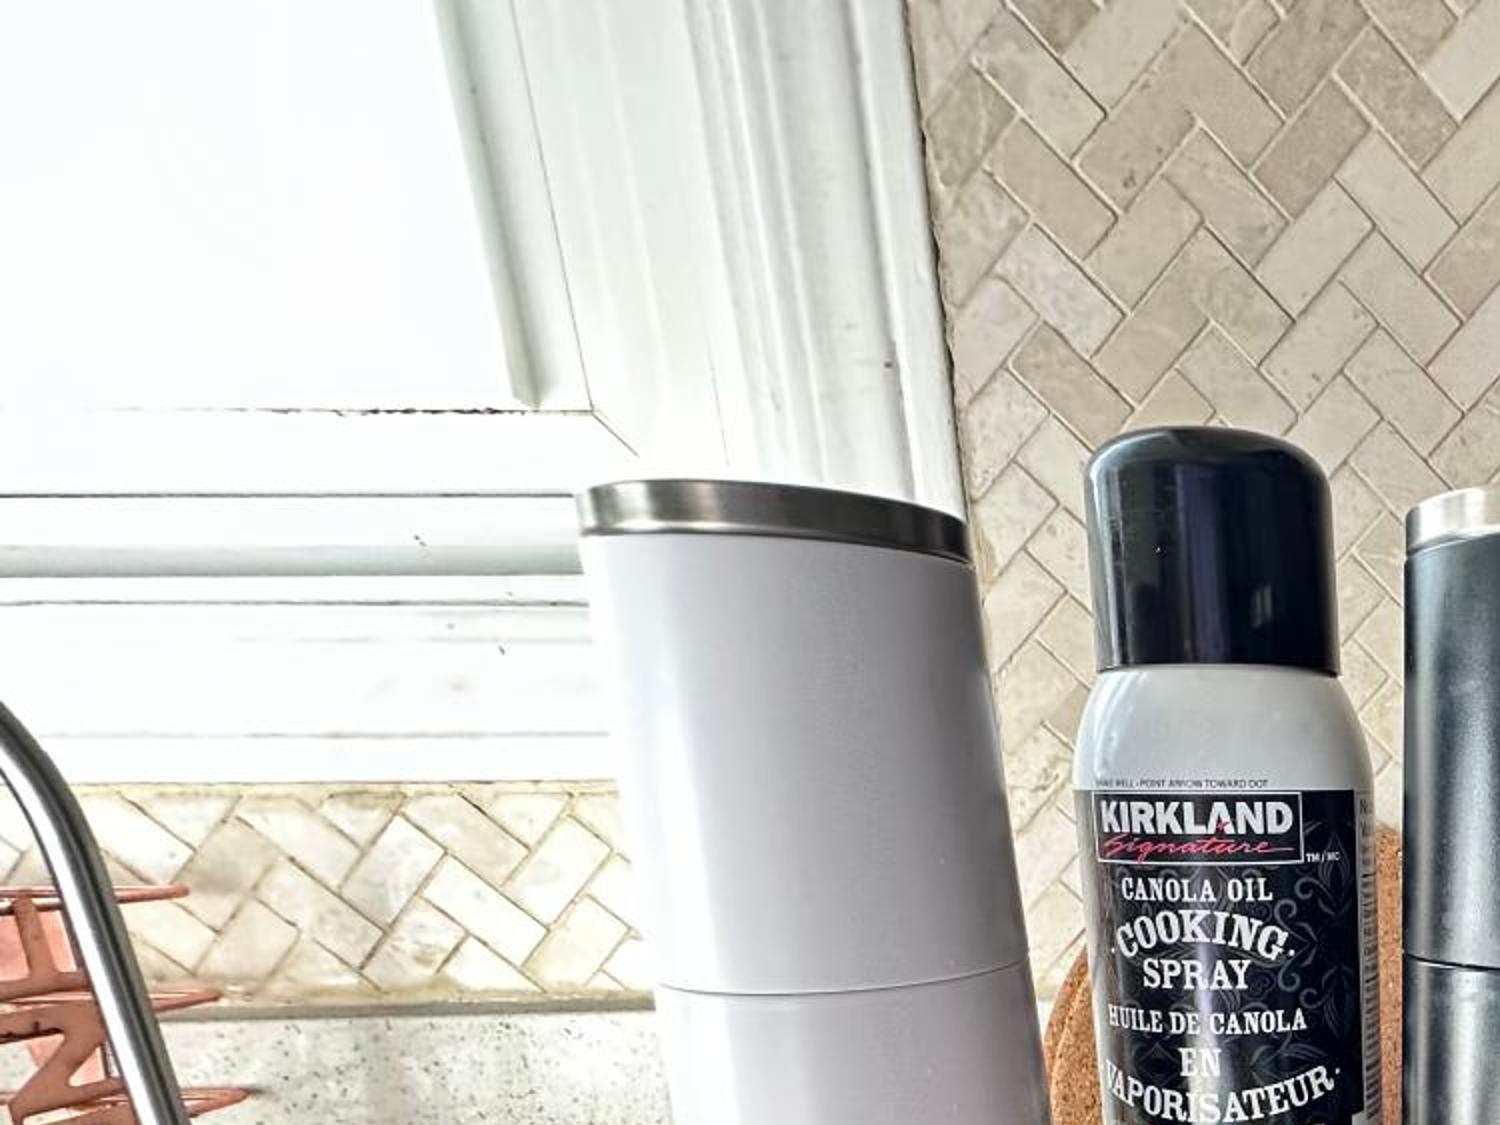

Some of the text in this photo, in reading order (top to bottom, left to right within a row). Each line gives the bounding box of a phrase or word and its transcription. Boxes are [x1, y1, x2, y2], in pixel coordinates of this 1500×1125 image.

[1099, 800, 1295, 835] KIRKLAND
[1102, 832, 1294, 863] Signature
[1121, 877, 1273, 901] CANOLA OIL
[1116, 908, 1289, 961] COOKING
[1142, 958, 1251, 991] SPRAY
[1107, 1003, 1308, 1035] HUILE DE CANOLA
[1179, 1047, 1222, 1077] EN
[1105, 1059, 1335, 1124] VAPORISATEUR
